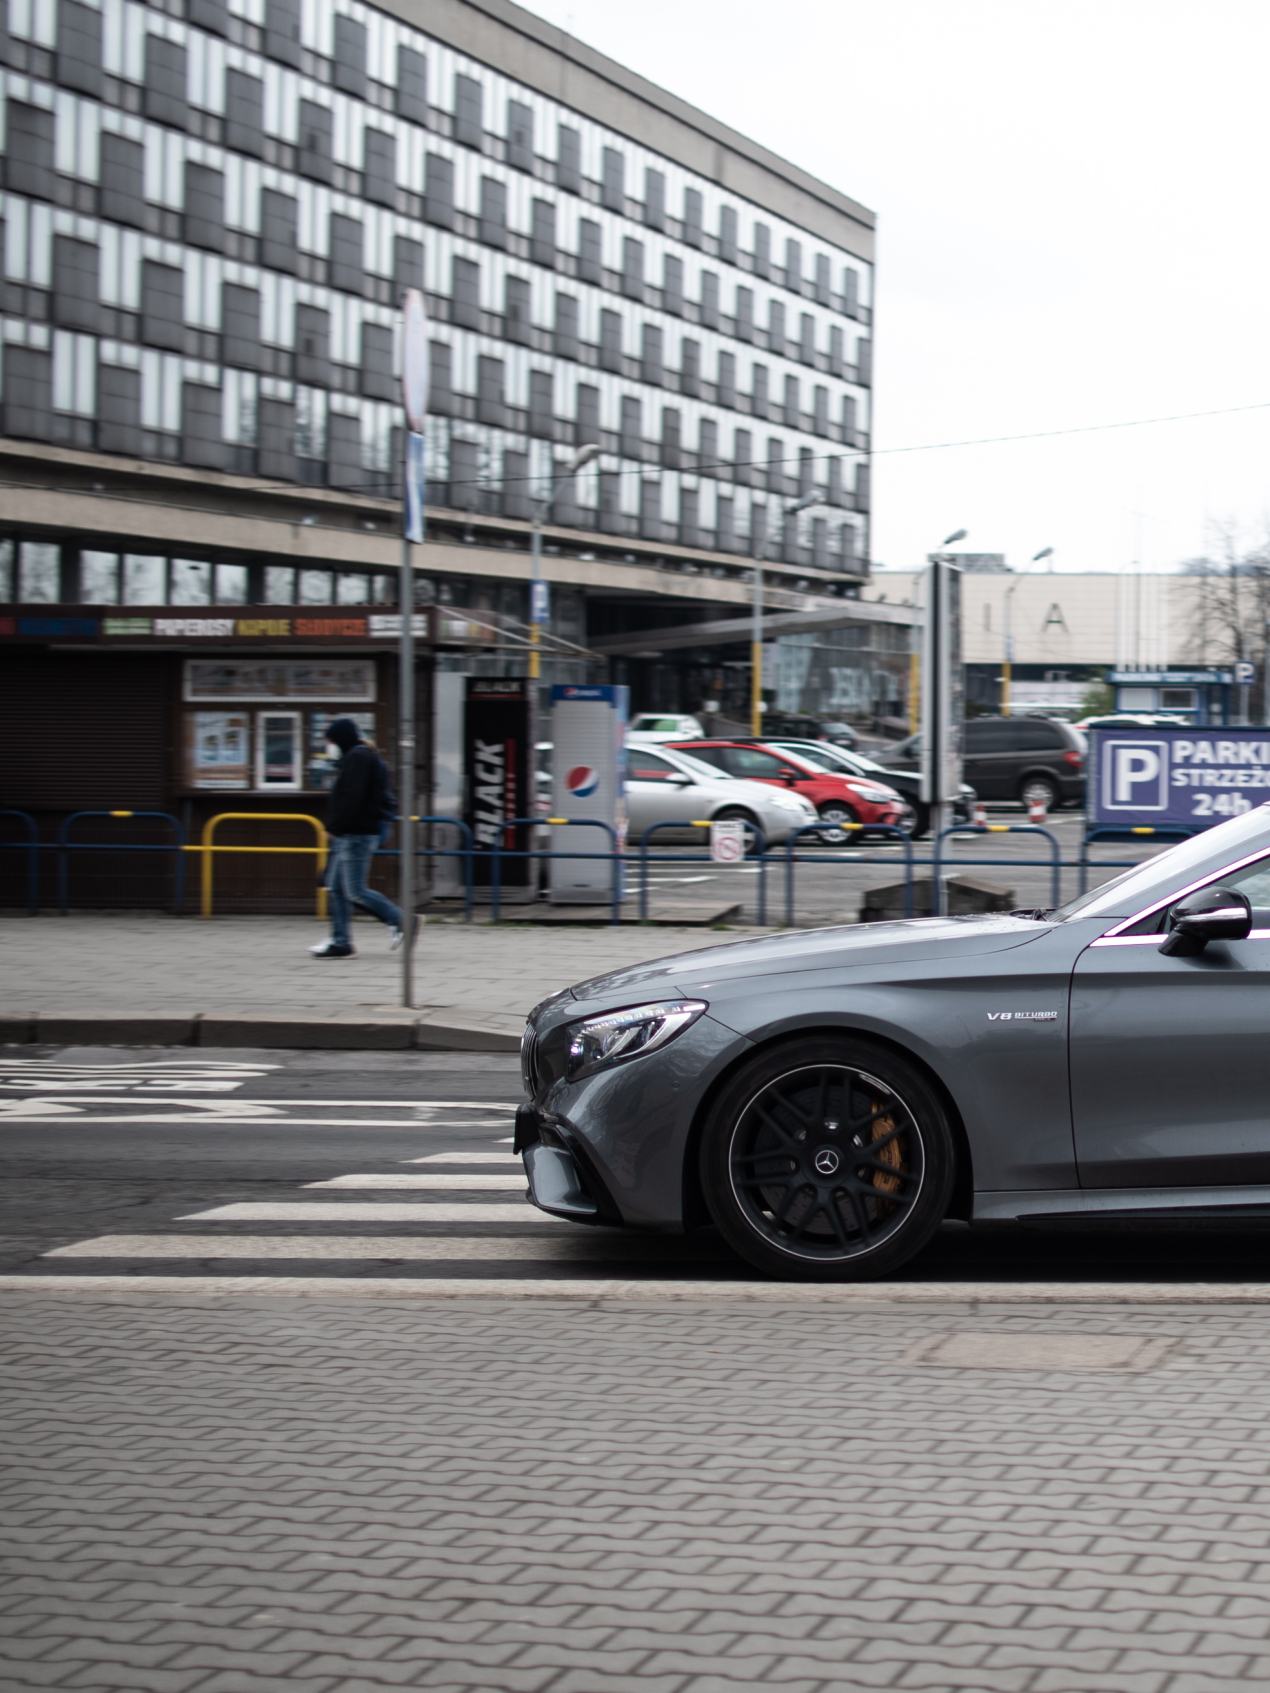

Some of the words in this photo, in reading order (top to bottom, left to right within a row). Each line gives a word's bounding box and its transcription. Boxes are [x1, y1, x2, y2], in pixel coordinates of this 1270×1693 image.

[474, 739, 504, 848] BLACK
[1114, 748, 1160, 801] P
[1191, 792, 1252, 816] 24h
[986, 1012, 1013, 1020] V8
